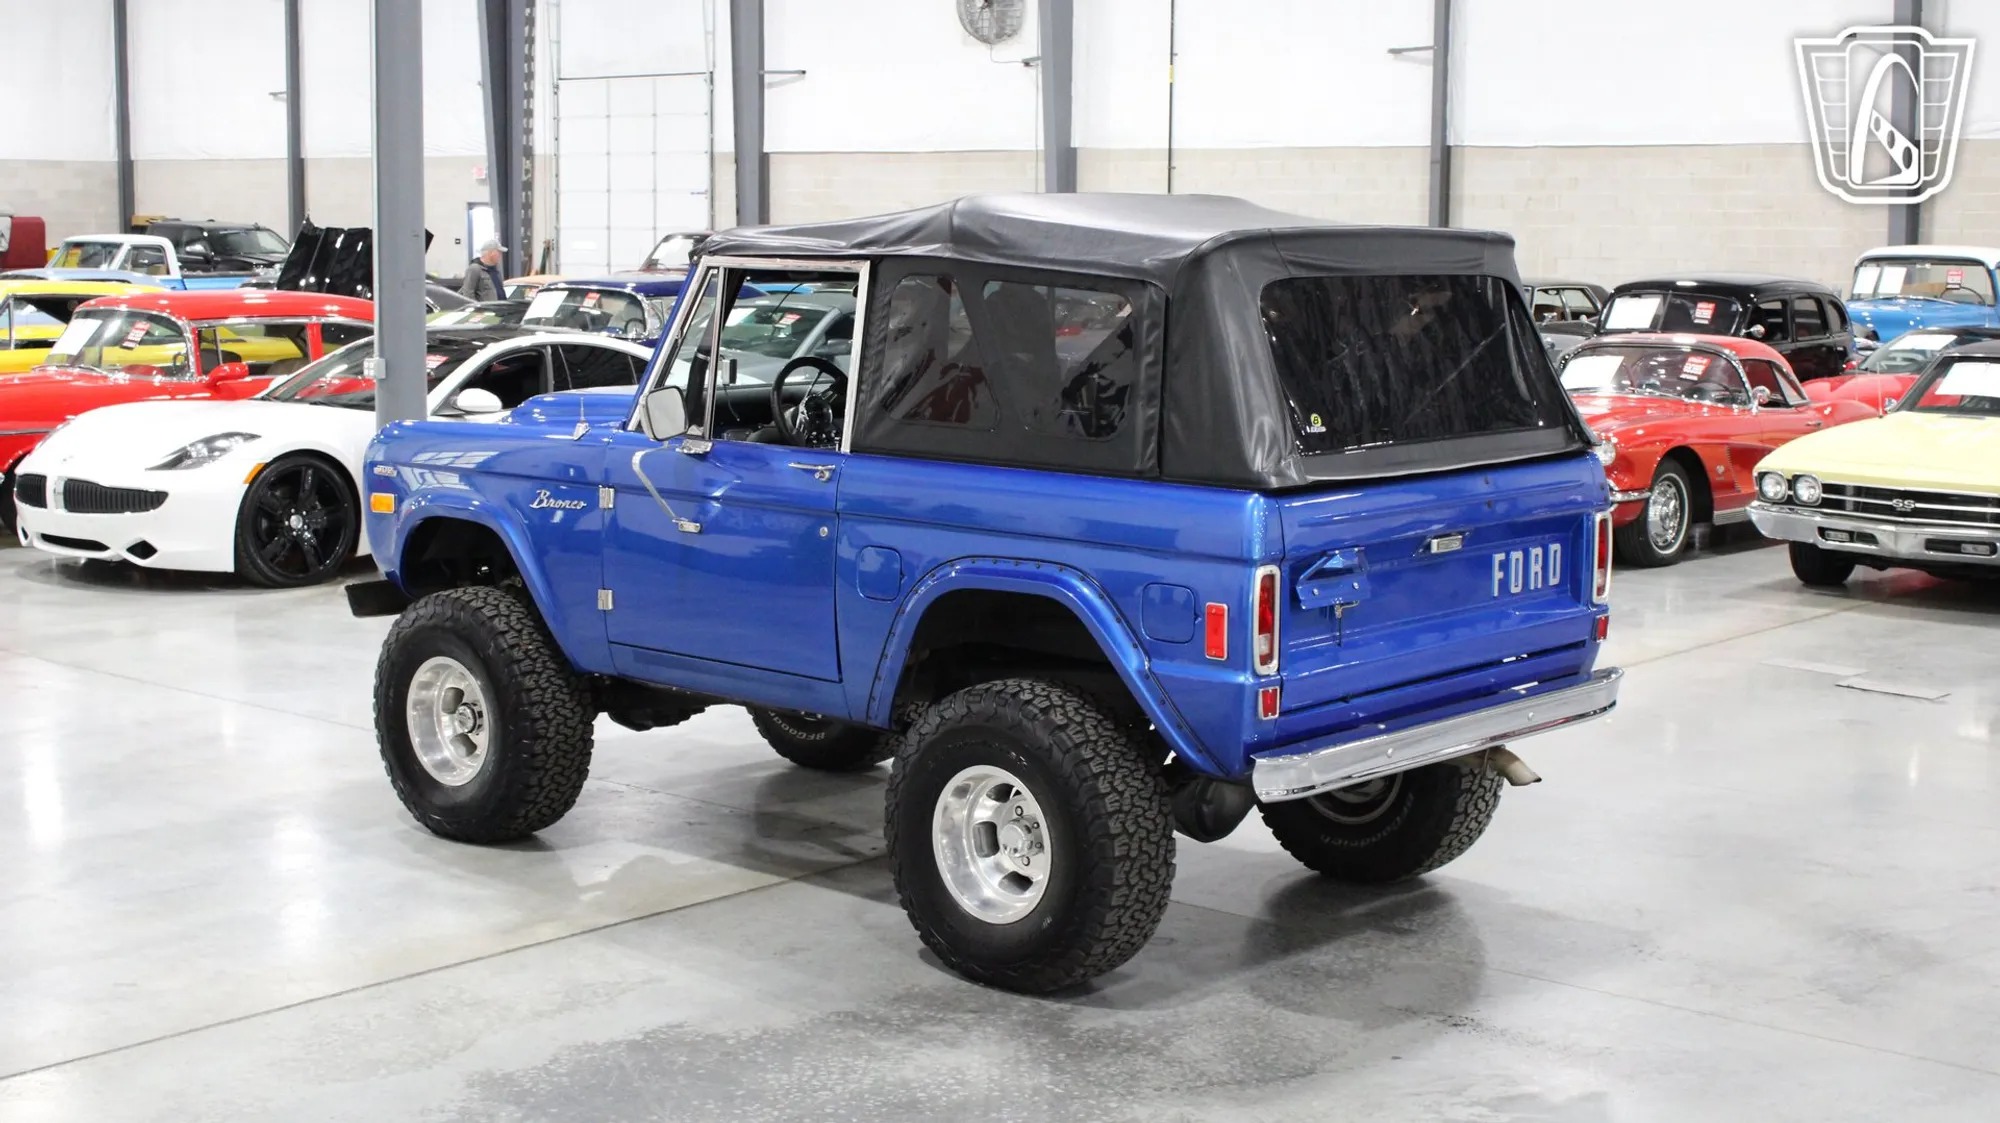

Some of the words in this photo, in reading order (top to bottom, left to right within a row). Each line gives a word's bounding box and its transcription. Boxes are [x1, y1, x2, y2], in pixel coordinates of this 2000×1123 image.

[529, 490, 587, 509] Bronco
[1892, 498, 1915, 508] SS
[1492, 544, 1561, 597] FORD
